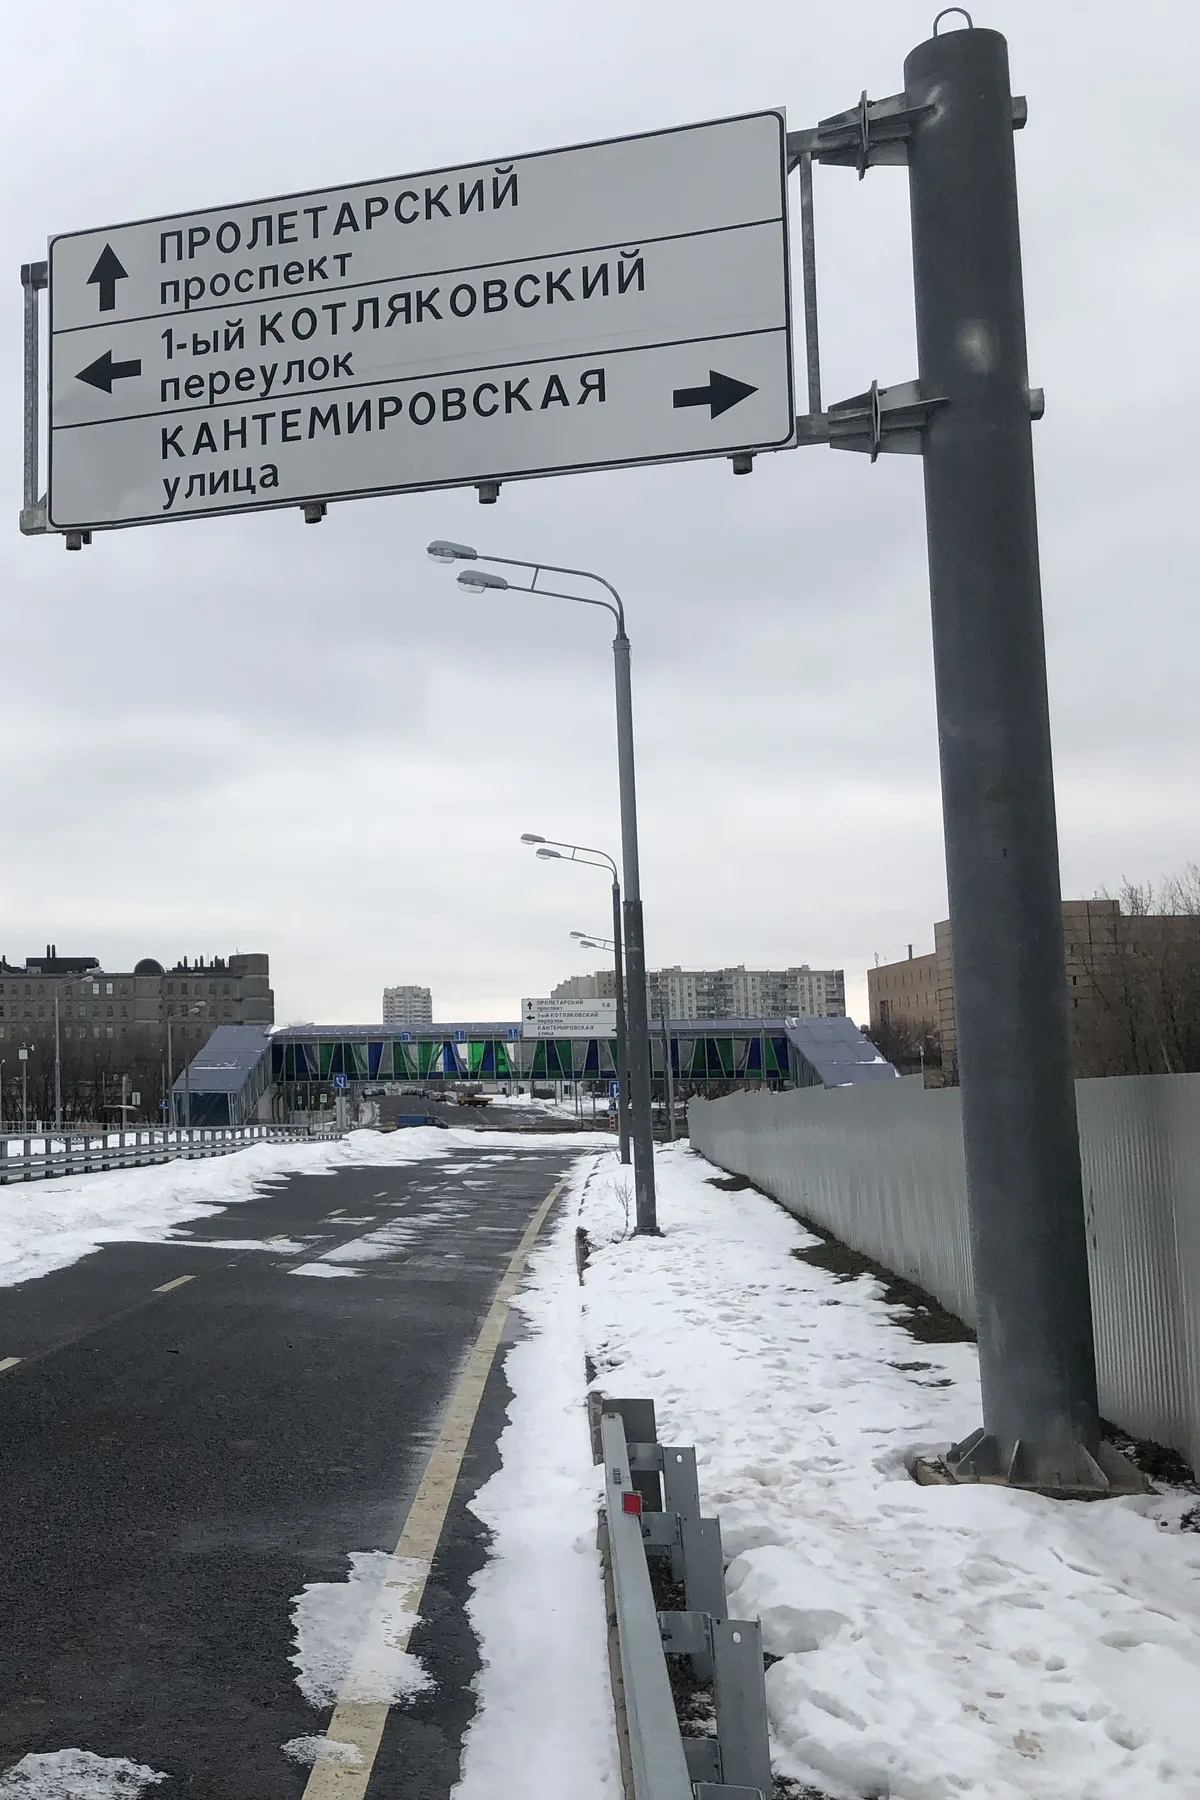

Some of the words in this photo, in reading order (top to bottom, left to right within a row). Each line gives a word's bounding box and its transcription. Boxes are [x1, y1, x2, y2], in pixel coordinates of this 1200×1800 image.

[160, 164, 518, 264] ПРОЛЕТАРСКИЙ
[160, 252, 353, 309] проспект
[160, 317, 245, 360] 1-ый
[259, 248, 645, 347] КОТЛЯКОВСКИЙ
[160, 351, 355, 404] переулок
[161, 367, 606, 460] КАНТЕМИРОВСКАЯ
[161, 463, 280, 511] улица
